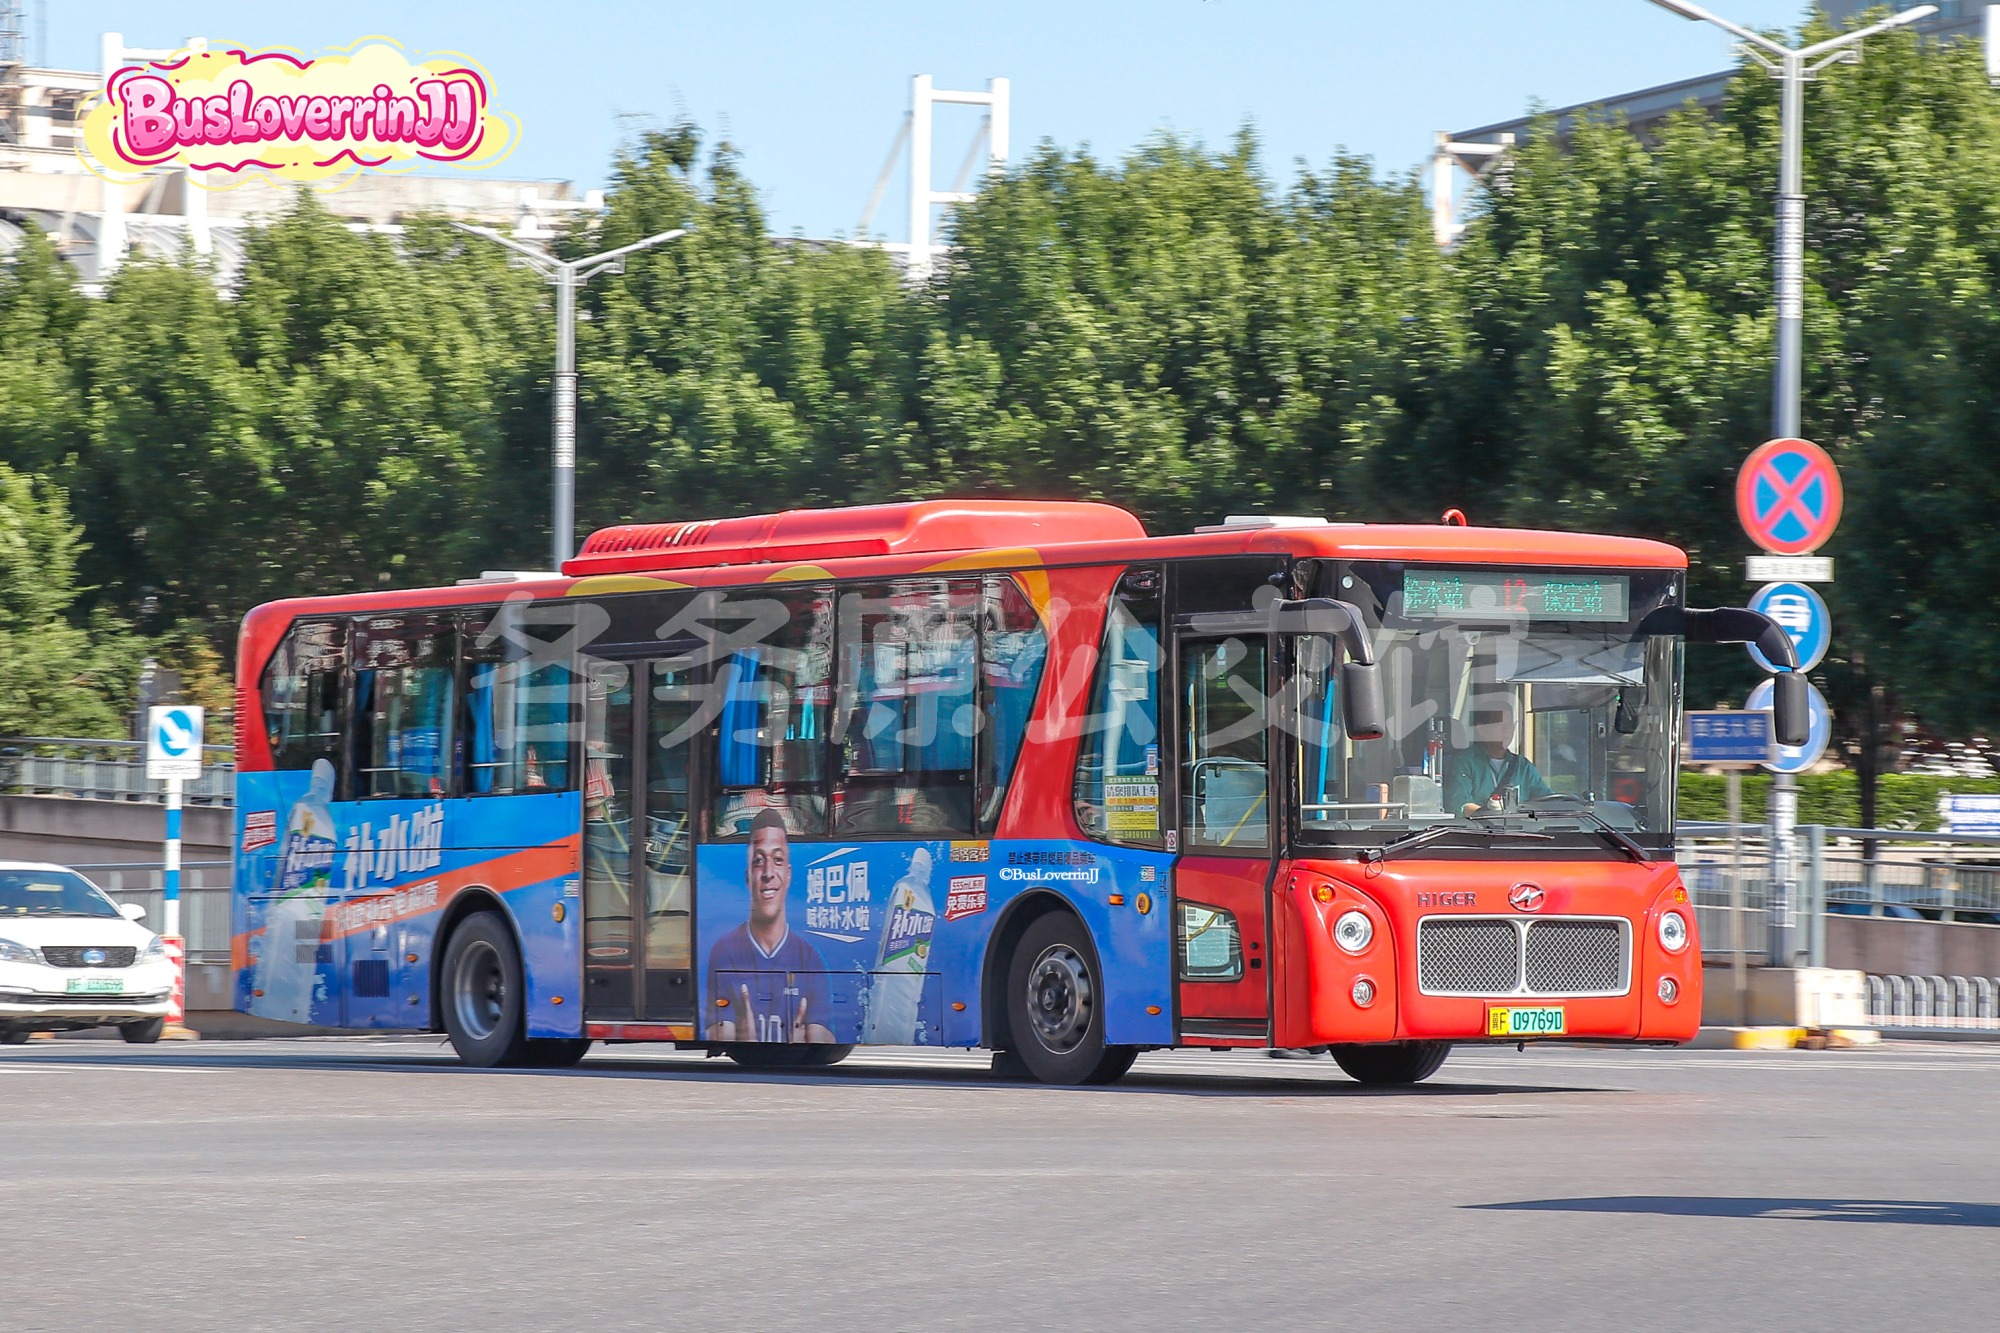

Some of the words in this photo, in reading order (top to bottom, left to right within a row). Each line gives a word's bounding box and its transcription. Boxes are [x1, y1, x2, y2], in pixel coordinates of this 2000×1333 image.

[1503, 578, 1528, 612] 12
[1106, 785, 1158, 797] 请您排队上车
[342, 802, 445, 892] 补水啦
[807, 861, 870, 904] 姆巴佩
[947, 893, 986, 911] 免费乐享
[1418, 891, 1476, 907] HIGER
[806, 905, 870, 931] 喊你补水啦
[758, 1013, 783, 1042] 10
[1513, 1011, 1562, 1030] 09769D
